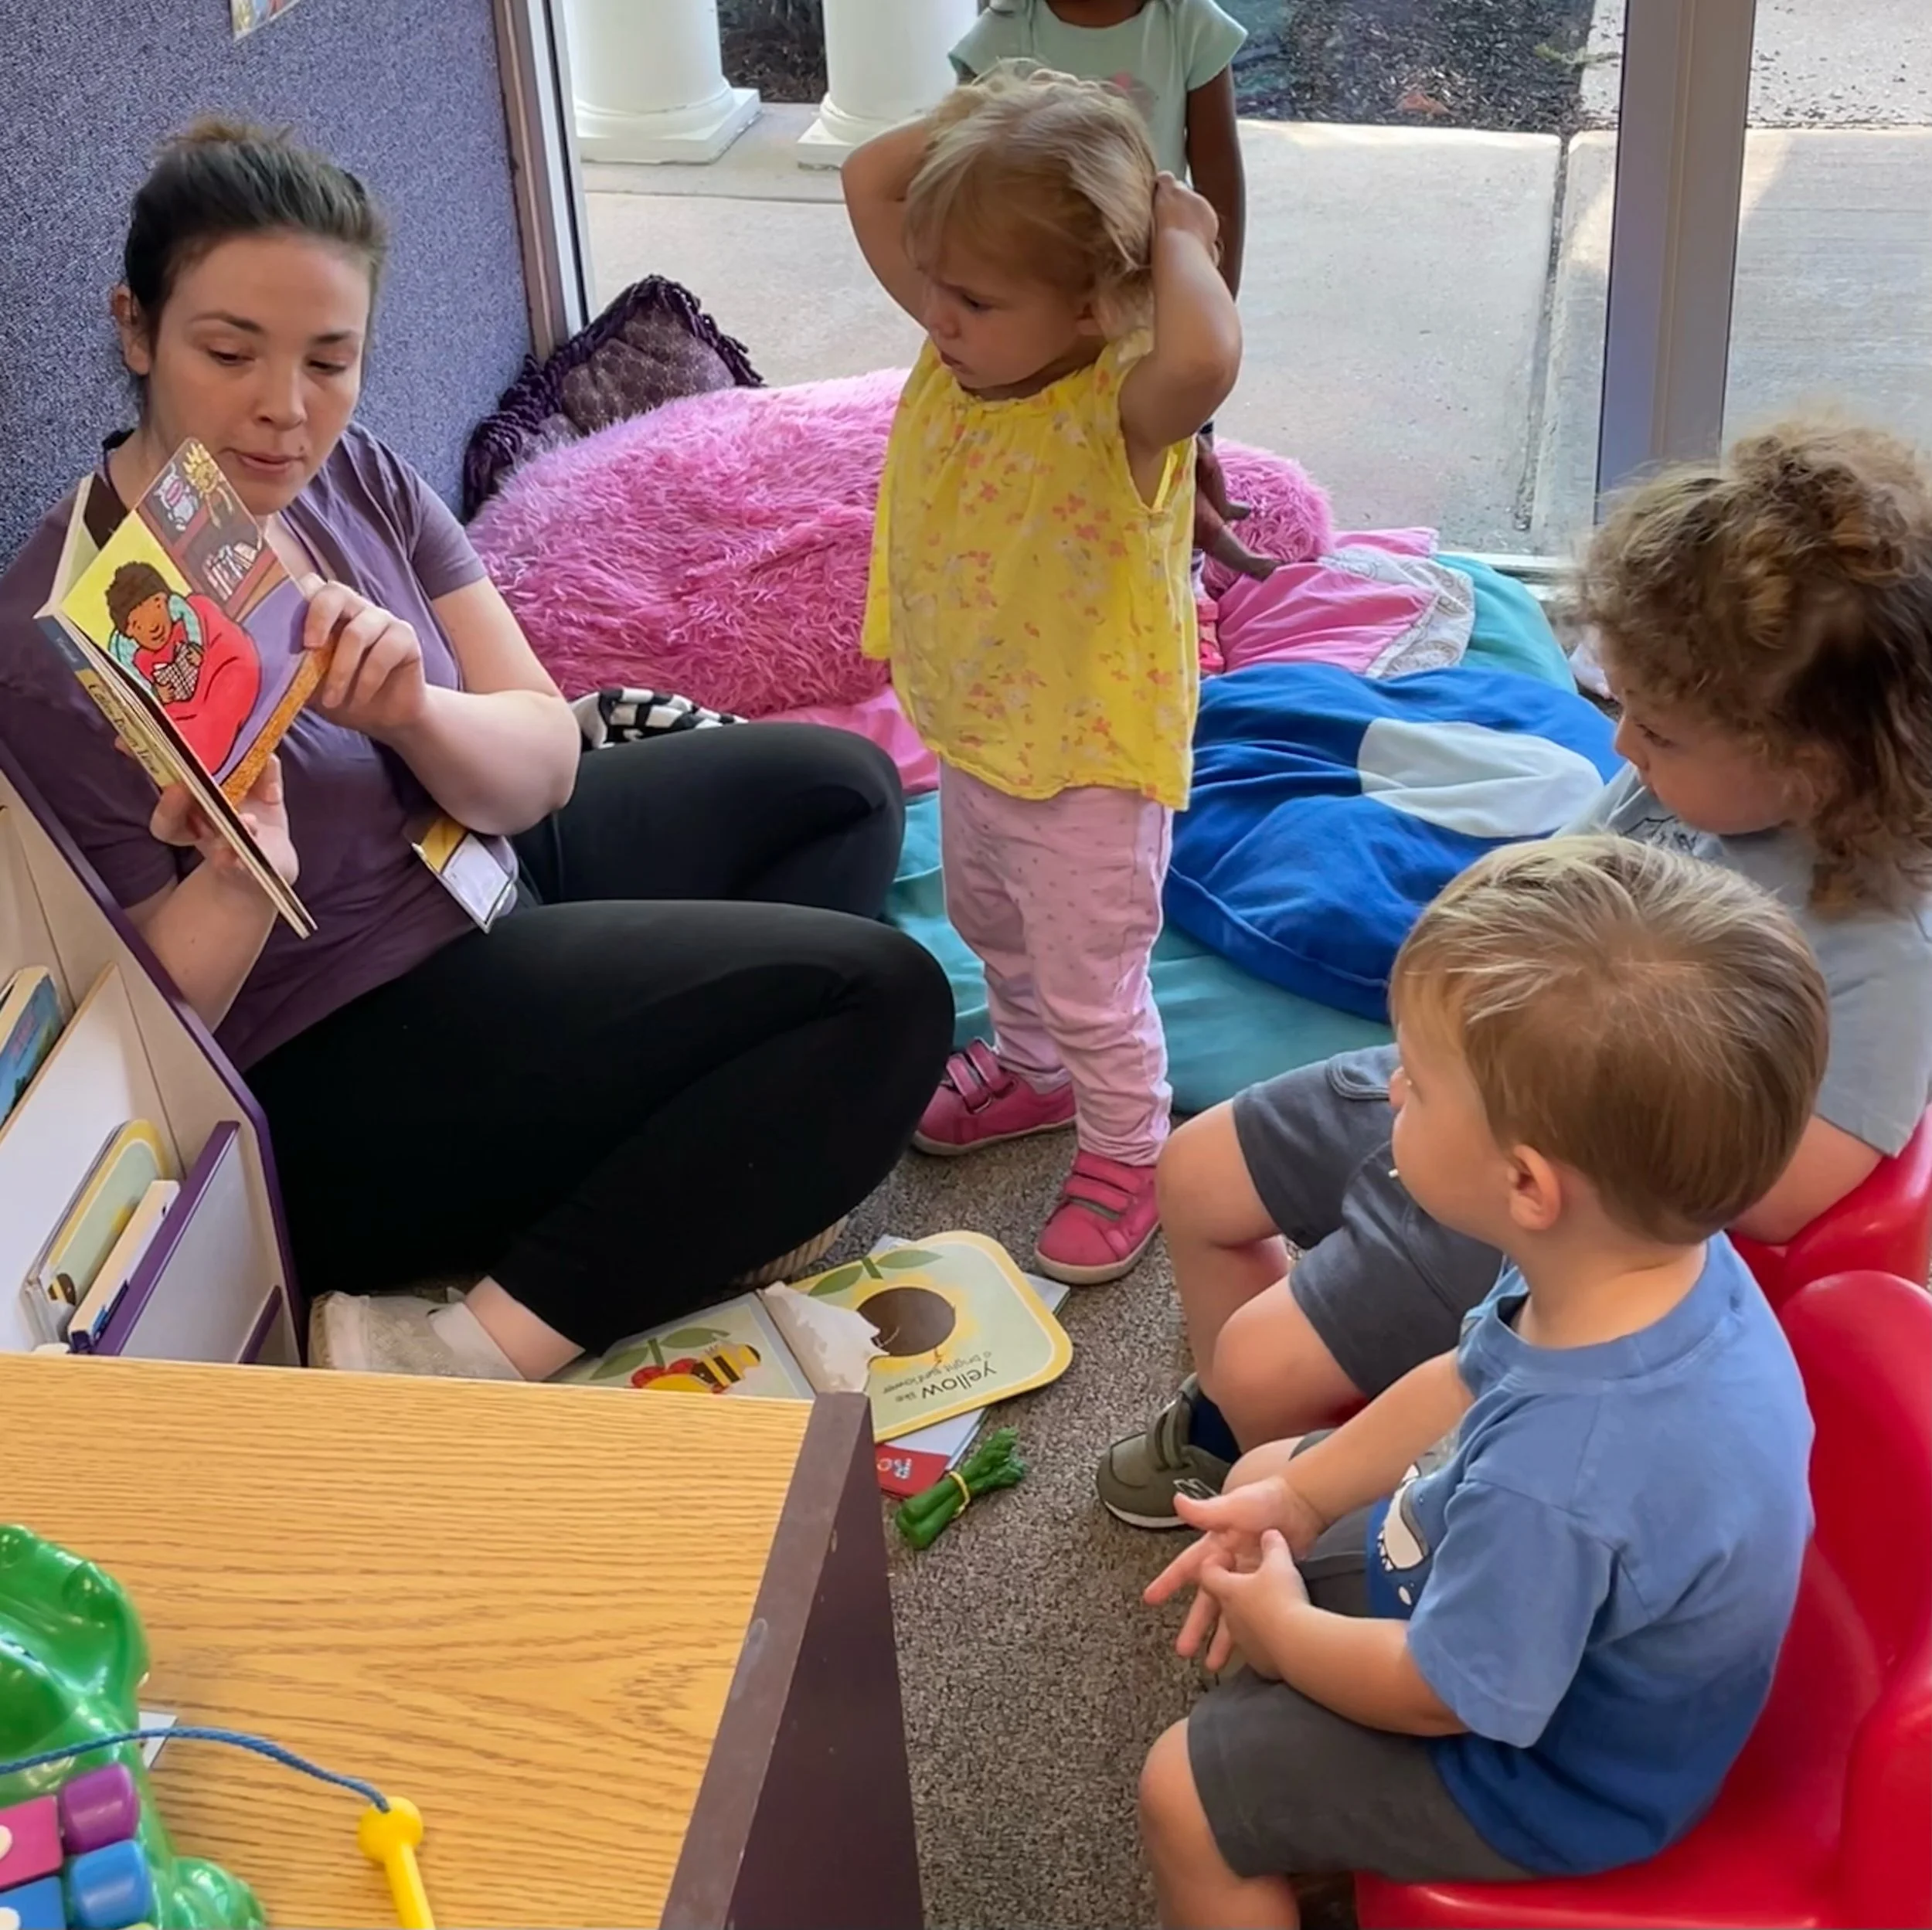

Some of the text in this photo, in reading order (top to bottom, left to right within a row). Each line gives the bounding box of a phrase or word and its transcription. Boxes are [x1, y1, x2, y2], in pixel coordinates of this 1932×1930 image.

[944, 1354, 982, 1373] bright
[883, 1366, 941, 1395] sunflower
[922, 1361, 997, 1398] yellow
